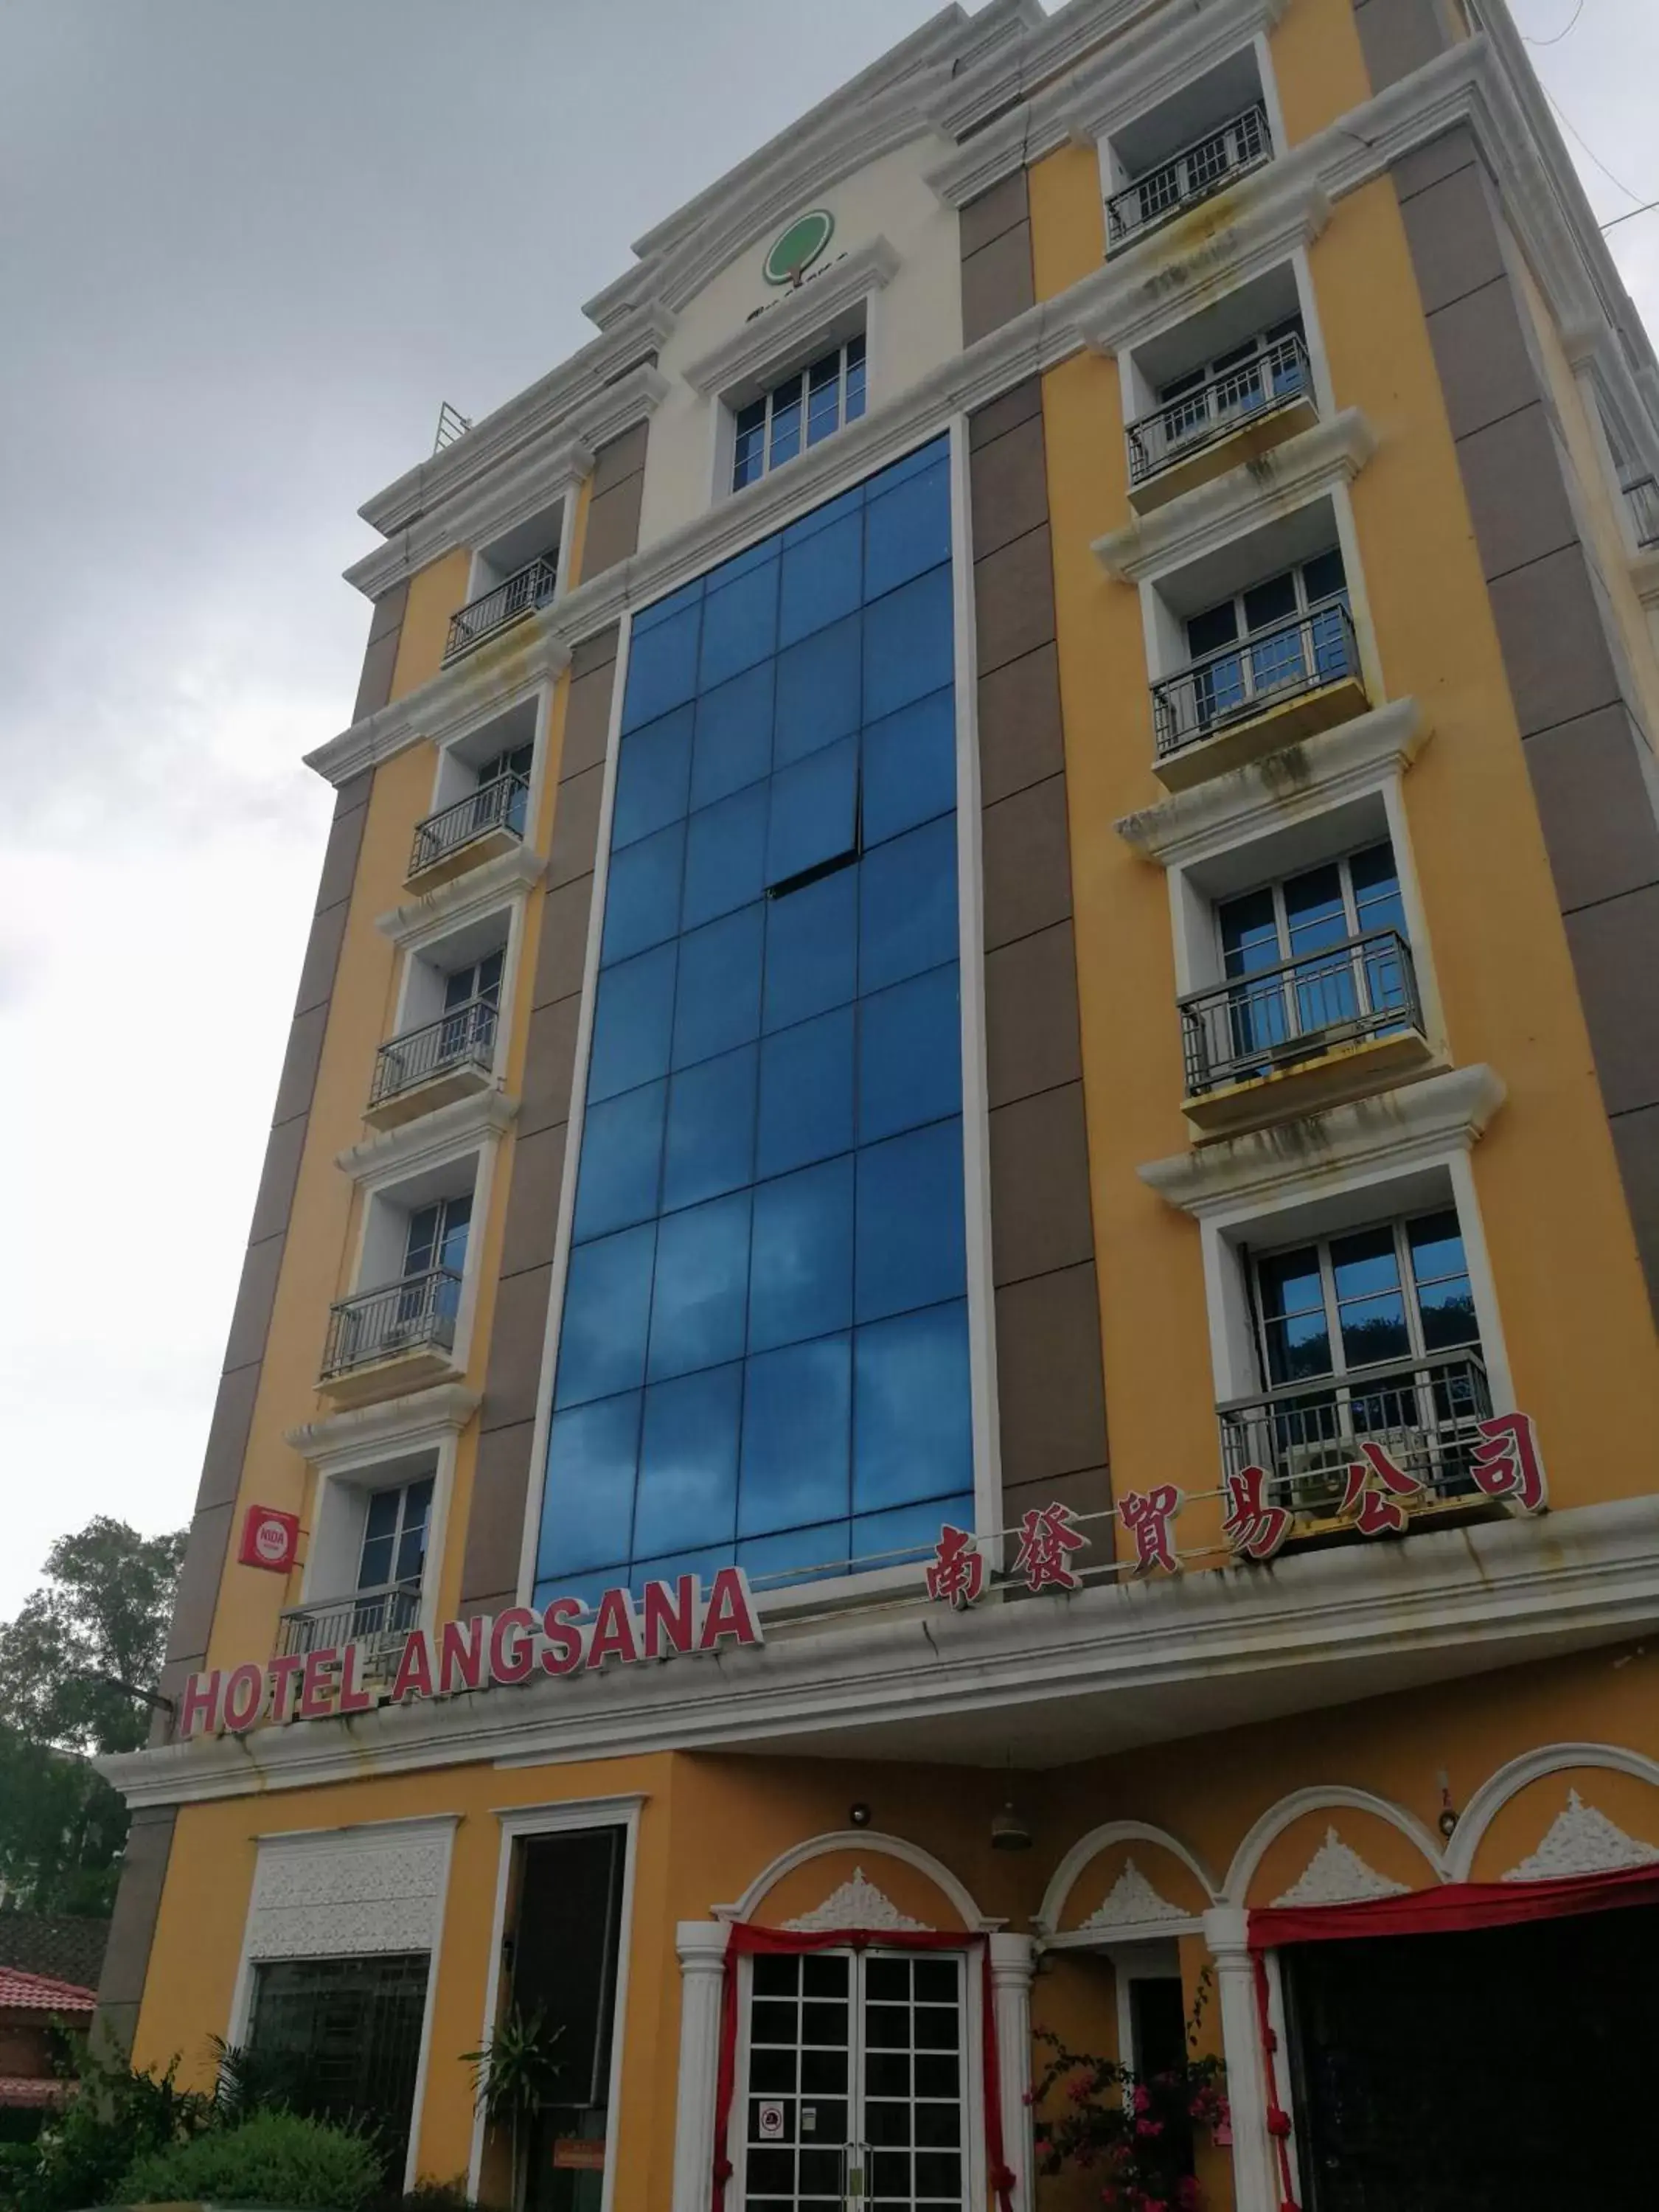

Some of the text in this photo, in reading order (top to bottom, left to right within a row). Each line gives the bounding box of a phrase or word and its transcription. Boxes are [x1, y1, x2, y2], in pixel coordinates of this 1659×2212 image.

[925, 1411, 1548, 1610] 南發貿易公司
[180, 1566, 758, 1737] HOTEL ANGSANA
